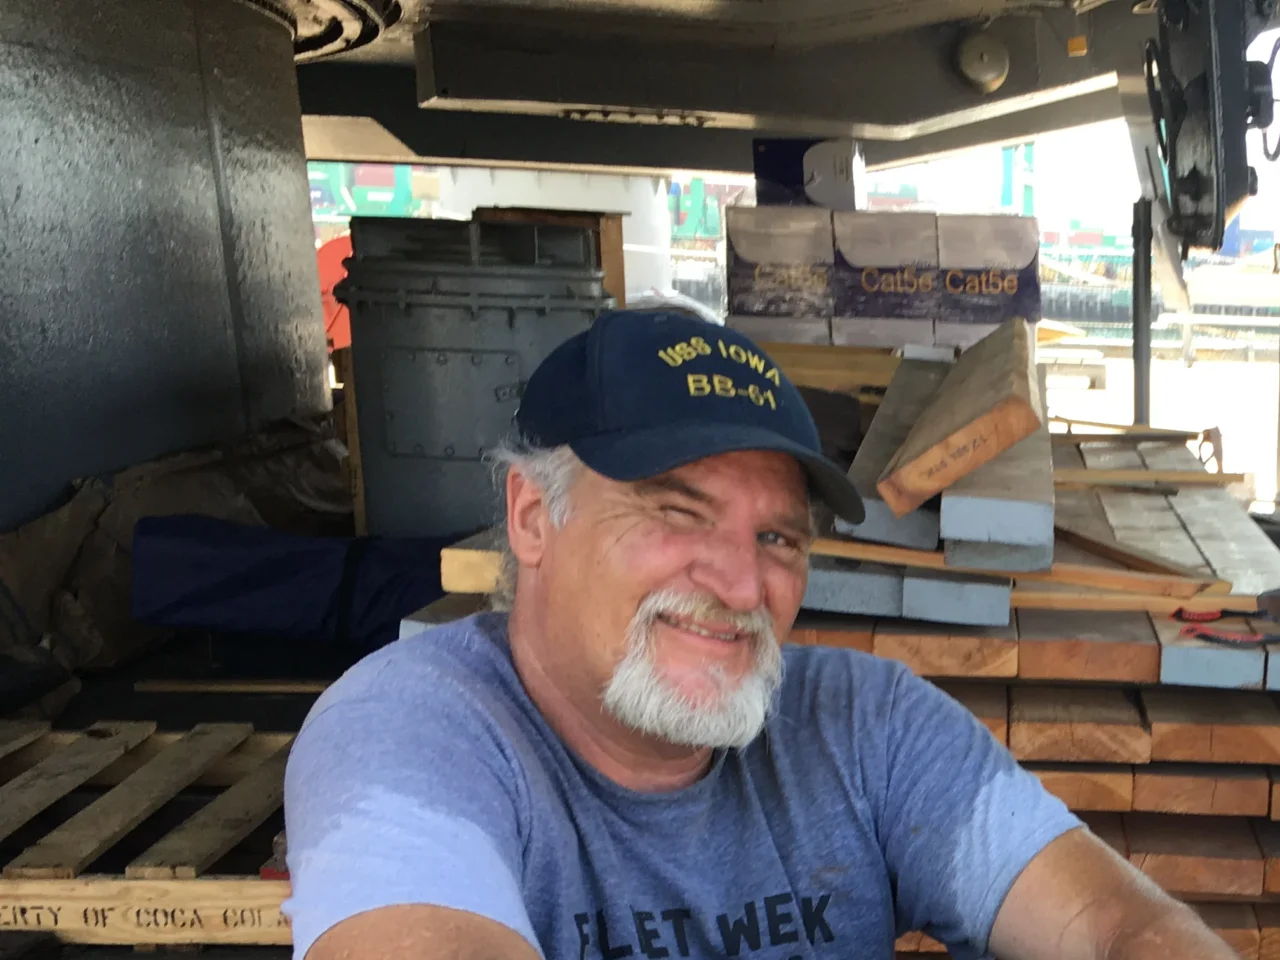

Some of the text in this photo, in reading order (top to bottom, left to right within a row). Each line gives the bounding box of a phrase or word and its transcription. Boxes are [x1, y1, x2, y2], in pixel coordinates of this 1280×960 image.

[861, 266, 933, 293] Cat5e
[945, 268, 1019, 295] Cat5e
[657, 336, 781, 388] USS IOWA
[687, 373, 777, 411] BB-61
[82, 907, 116, 928] OF
[135, 906, 204, 928] COCA
